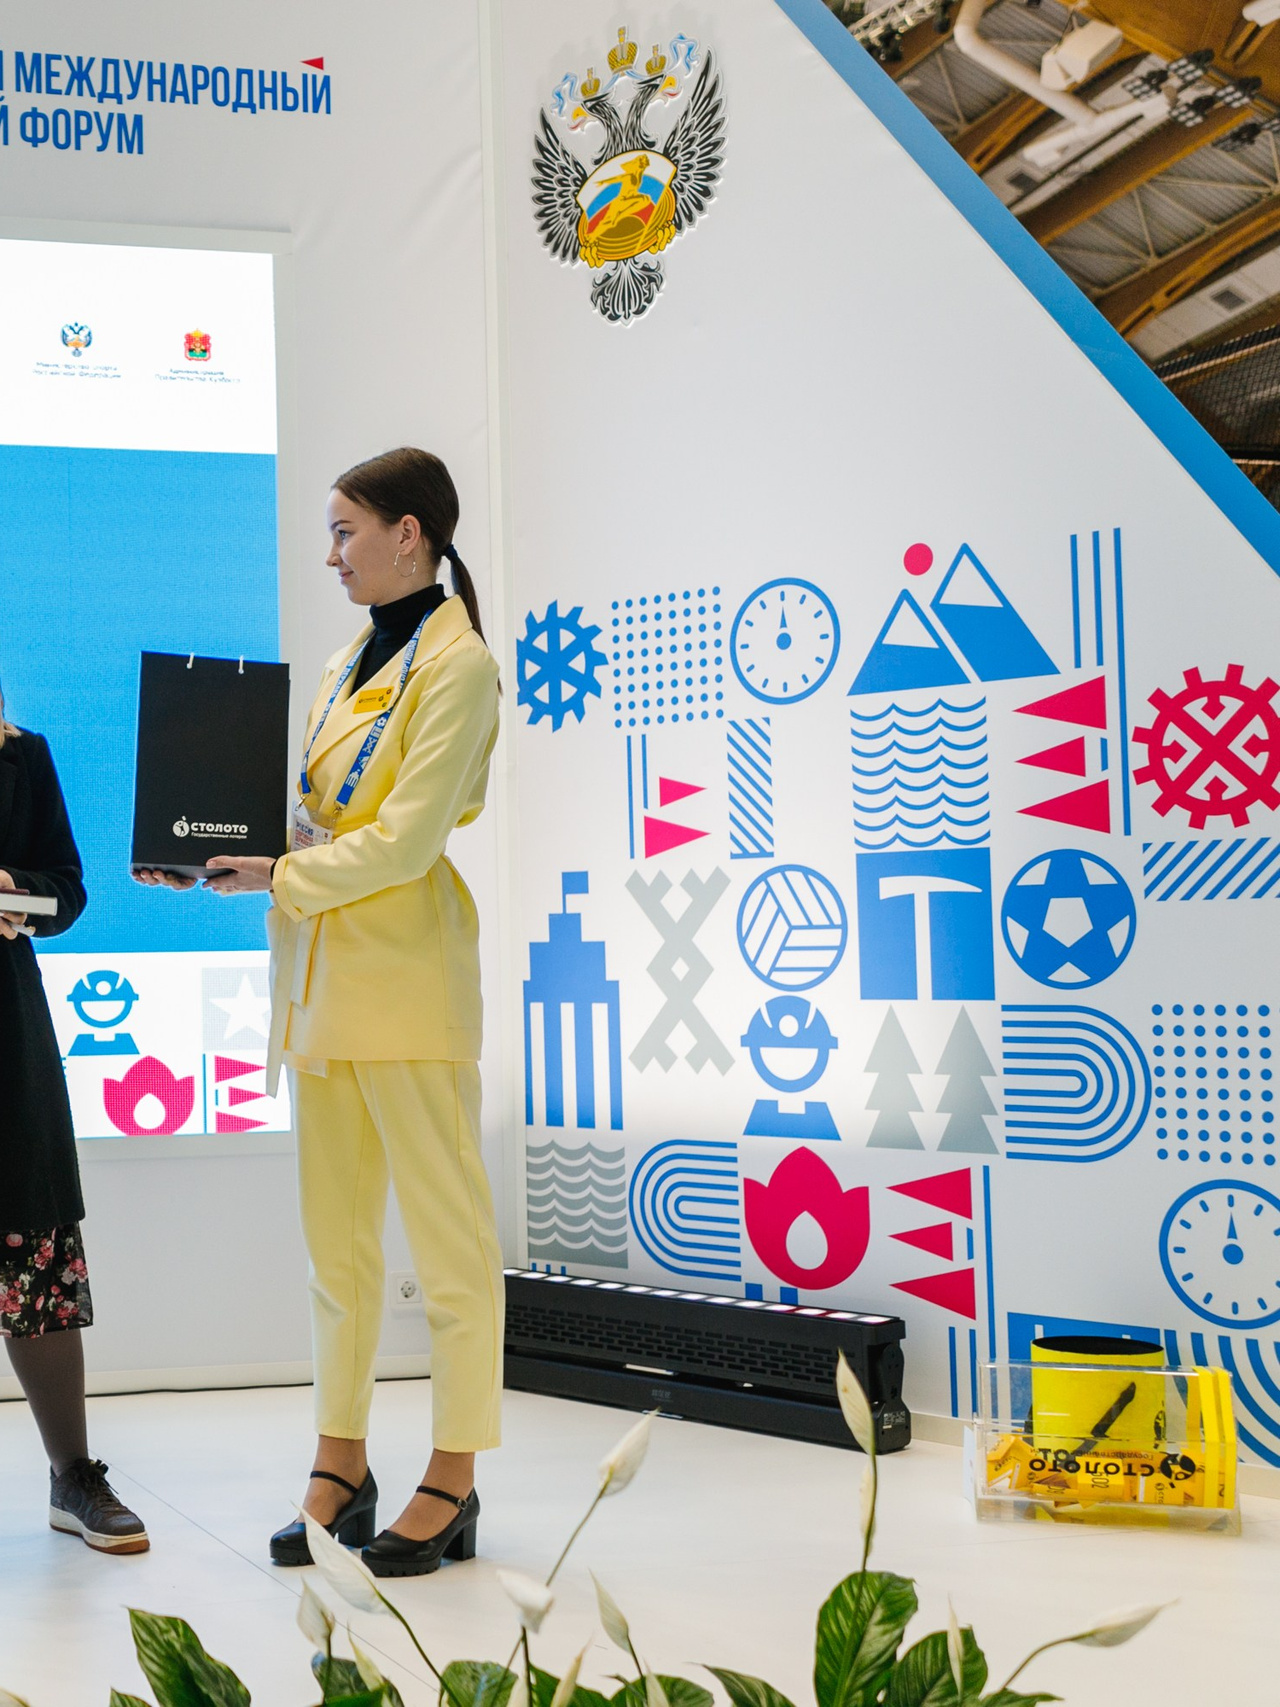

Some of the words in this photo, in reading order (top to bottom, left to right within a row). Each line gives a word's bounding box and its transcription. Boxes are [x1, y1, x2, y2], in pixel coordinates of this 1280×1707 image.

[15, 51, 331, 115] МЕЖДУНАРОДНЫЙ
[20, 106, 144, 155] ФОРУМ
[190, 822, 249, 834] СТОЛОТО
[1028, 1458, 1155, 1478] СТОЛОТО
